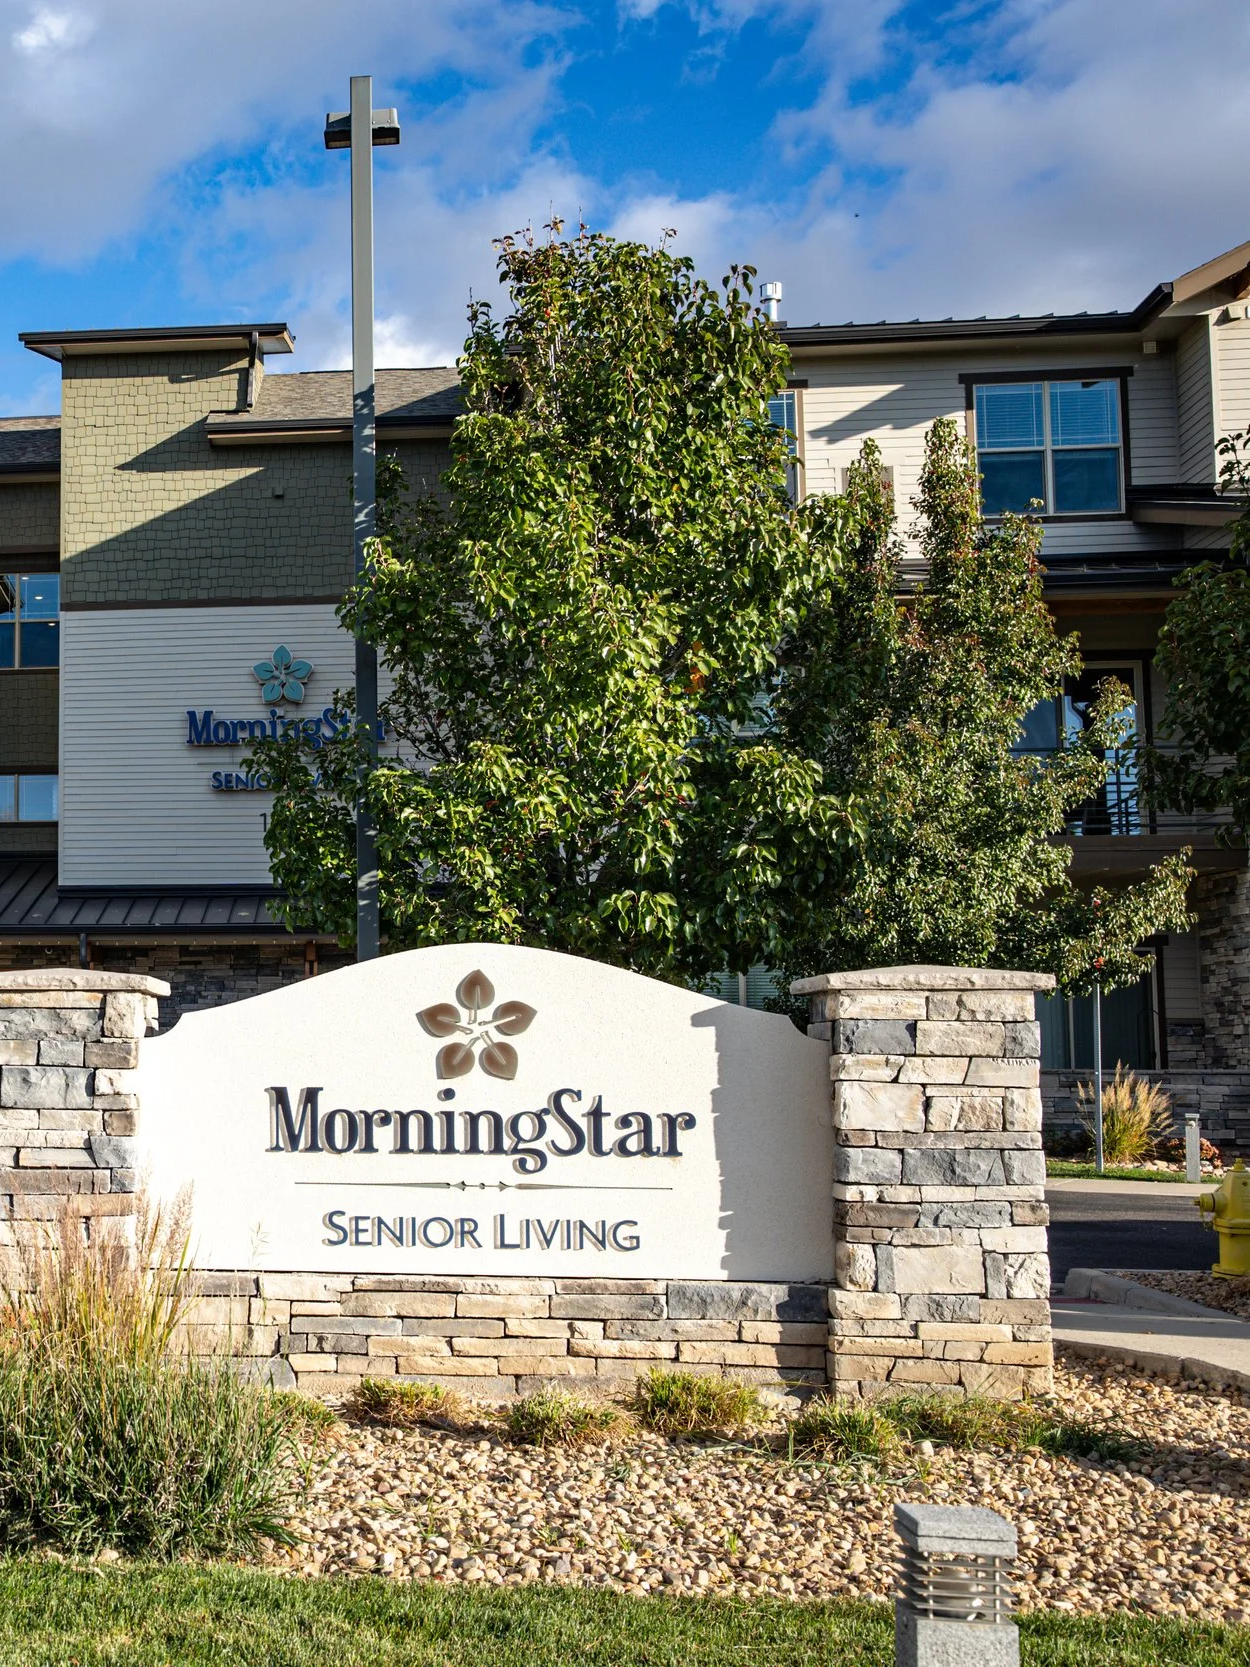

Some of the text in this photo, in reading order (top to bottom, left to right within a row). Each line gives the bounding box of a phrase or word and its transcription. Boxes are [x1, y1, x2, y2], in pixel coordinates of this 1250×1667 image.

[186, 707, 387, 749] MorningSt
[211, 771, 282, 790] SENIO
[264, 1086, 697, 1174] MorningStar
[322, 1210, 641, 1252] SENIOR LIVING
